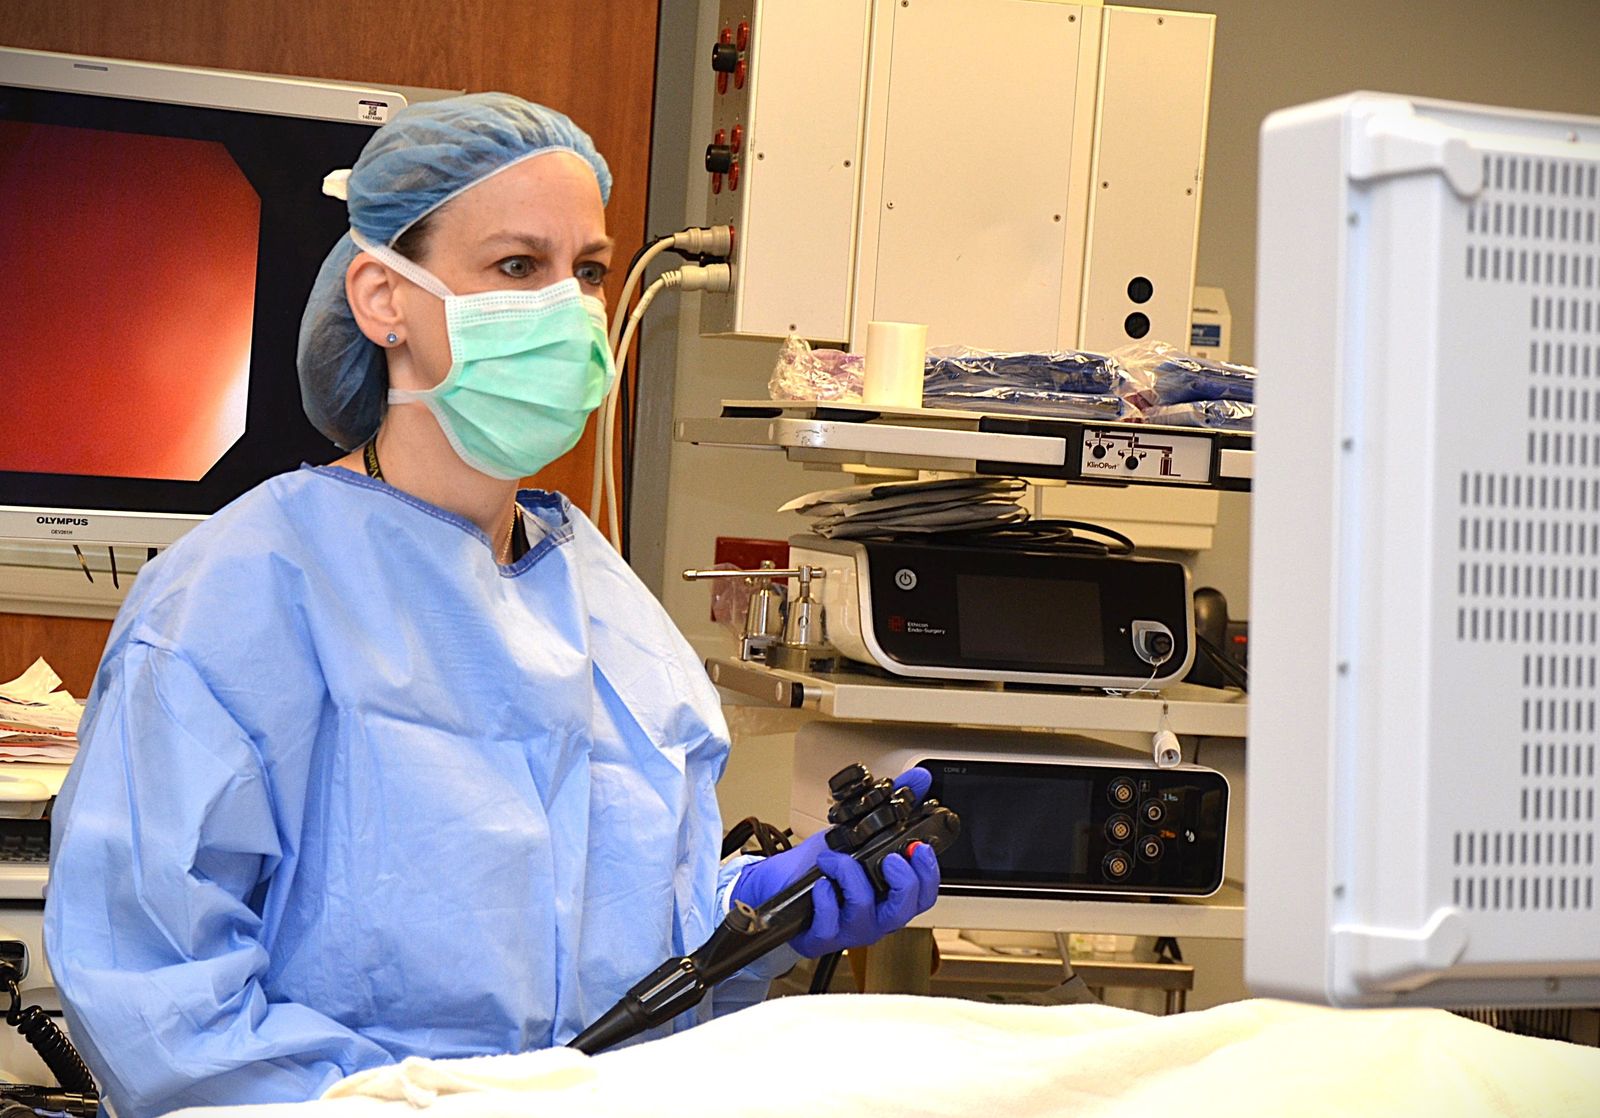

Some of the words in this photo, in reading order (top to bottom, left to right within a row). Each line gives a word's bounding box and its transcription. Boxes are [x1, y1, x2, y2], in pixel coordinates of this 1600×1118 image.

[1086, 461, 1117, 470] KlinOPort
[36, 516, 89, 526] OLYMPUS
[907, 627, 946, 635] Endo-Surgery
